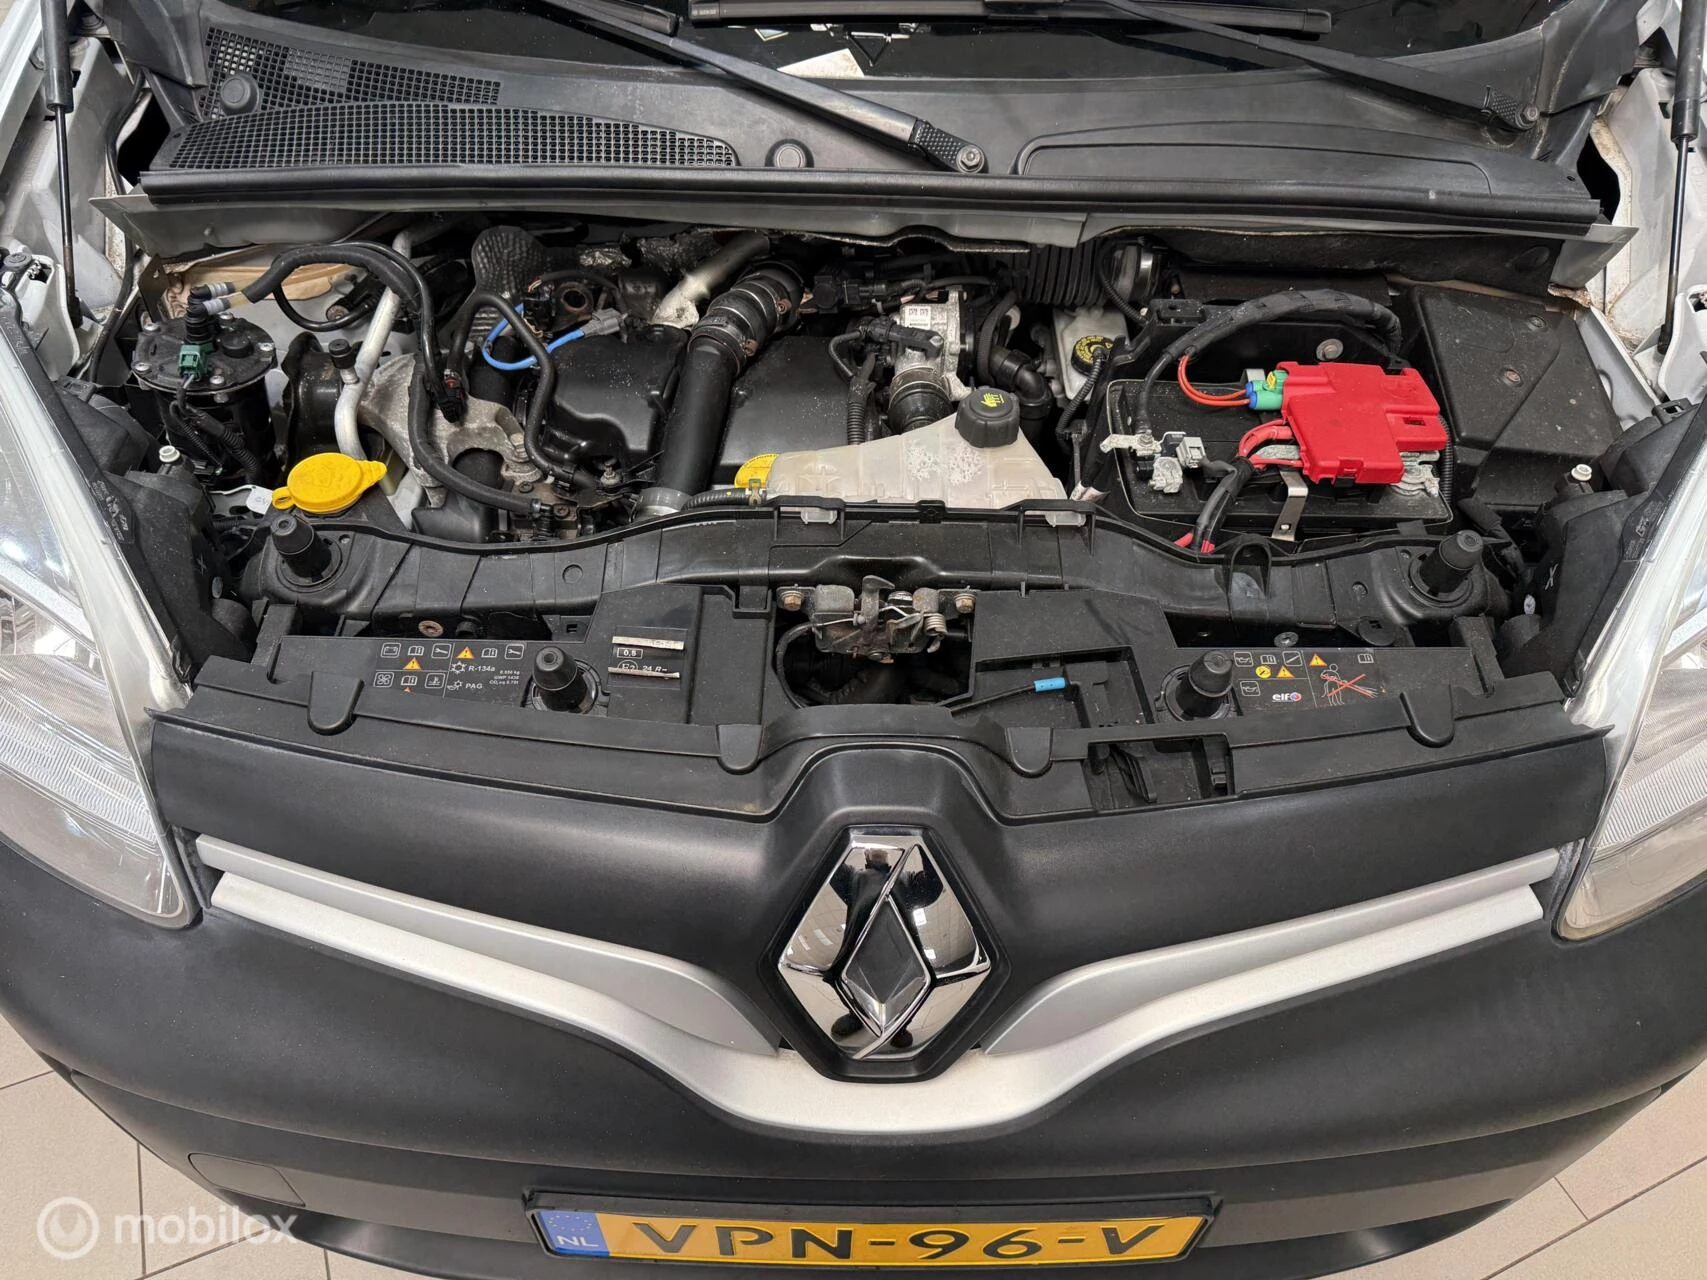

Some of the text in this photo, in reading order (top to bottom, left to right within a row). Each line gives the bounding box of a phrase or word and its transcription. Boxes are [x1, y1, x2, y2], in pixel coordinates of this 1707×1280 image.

[1272, 692, 1290, 701] elf
[556, 1235, 599, 1248] NL
[632, 1221, 1166, 1260] VPN-96-V
